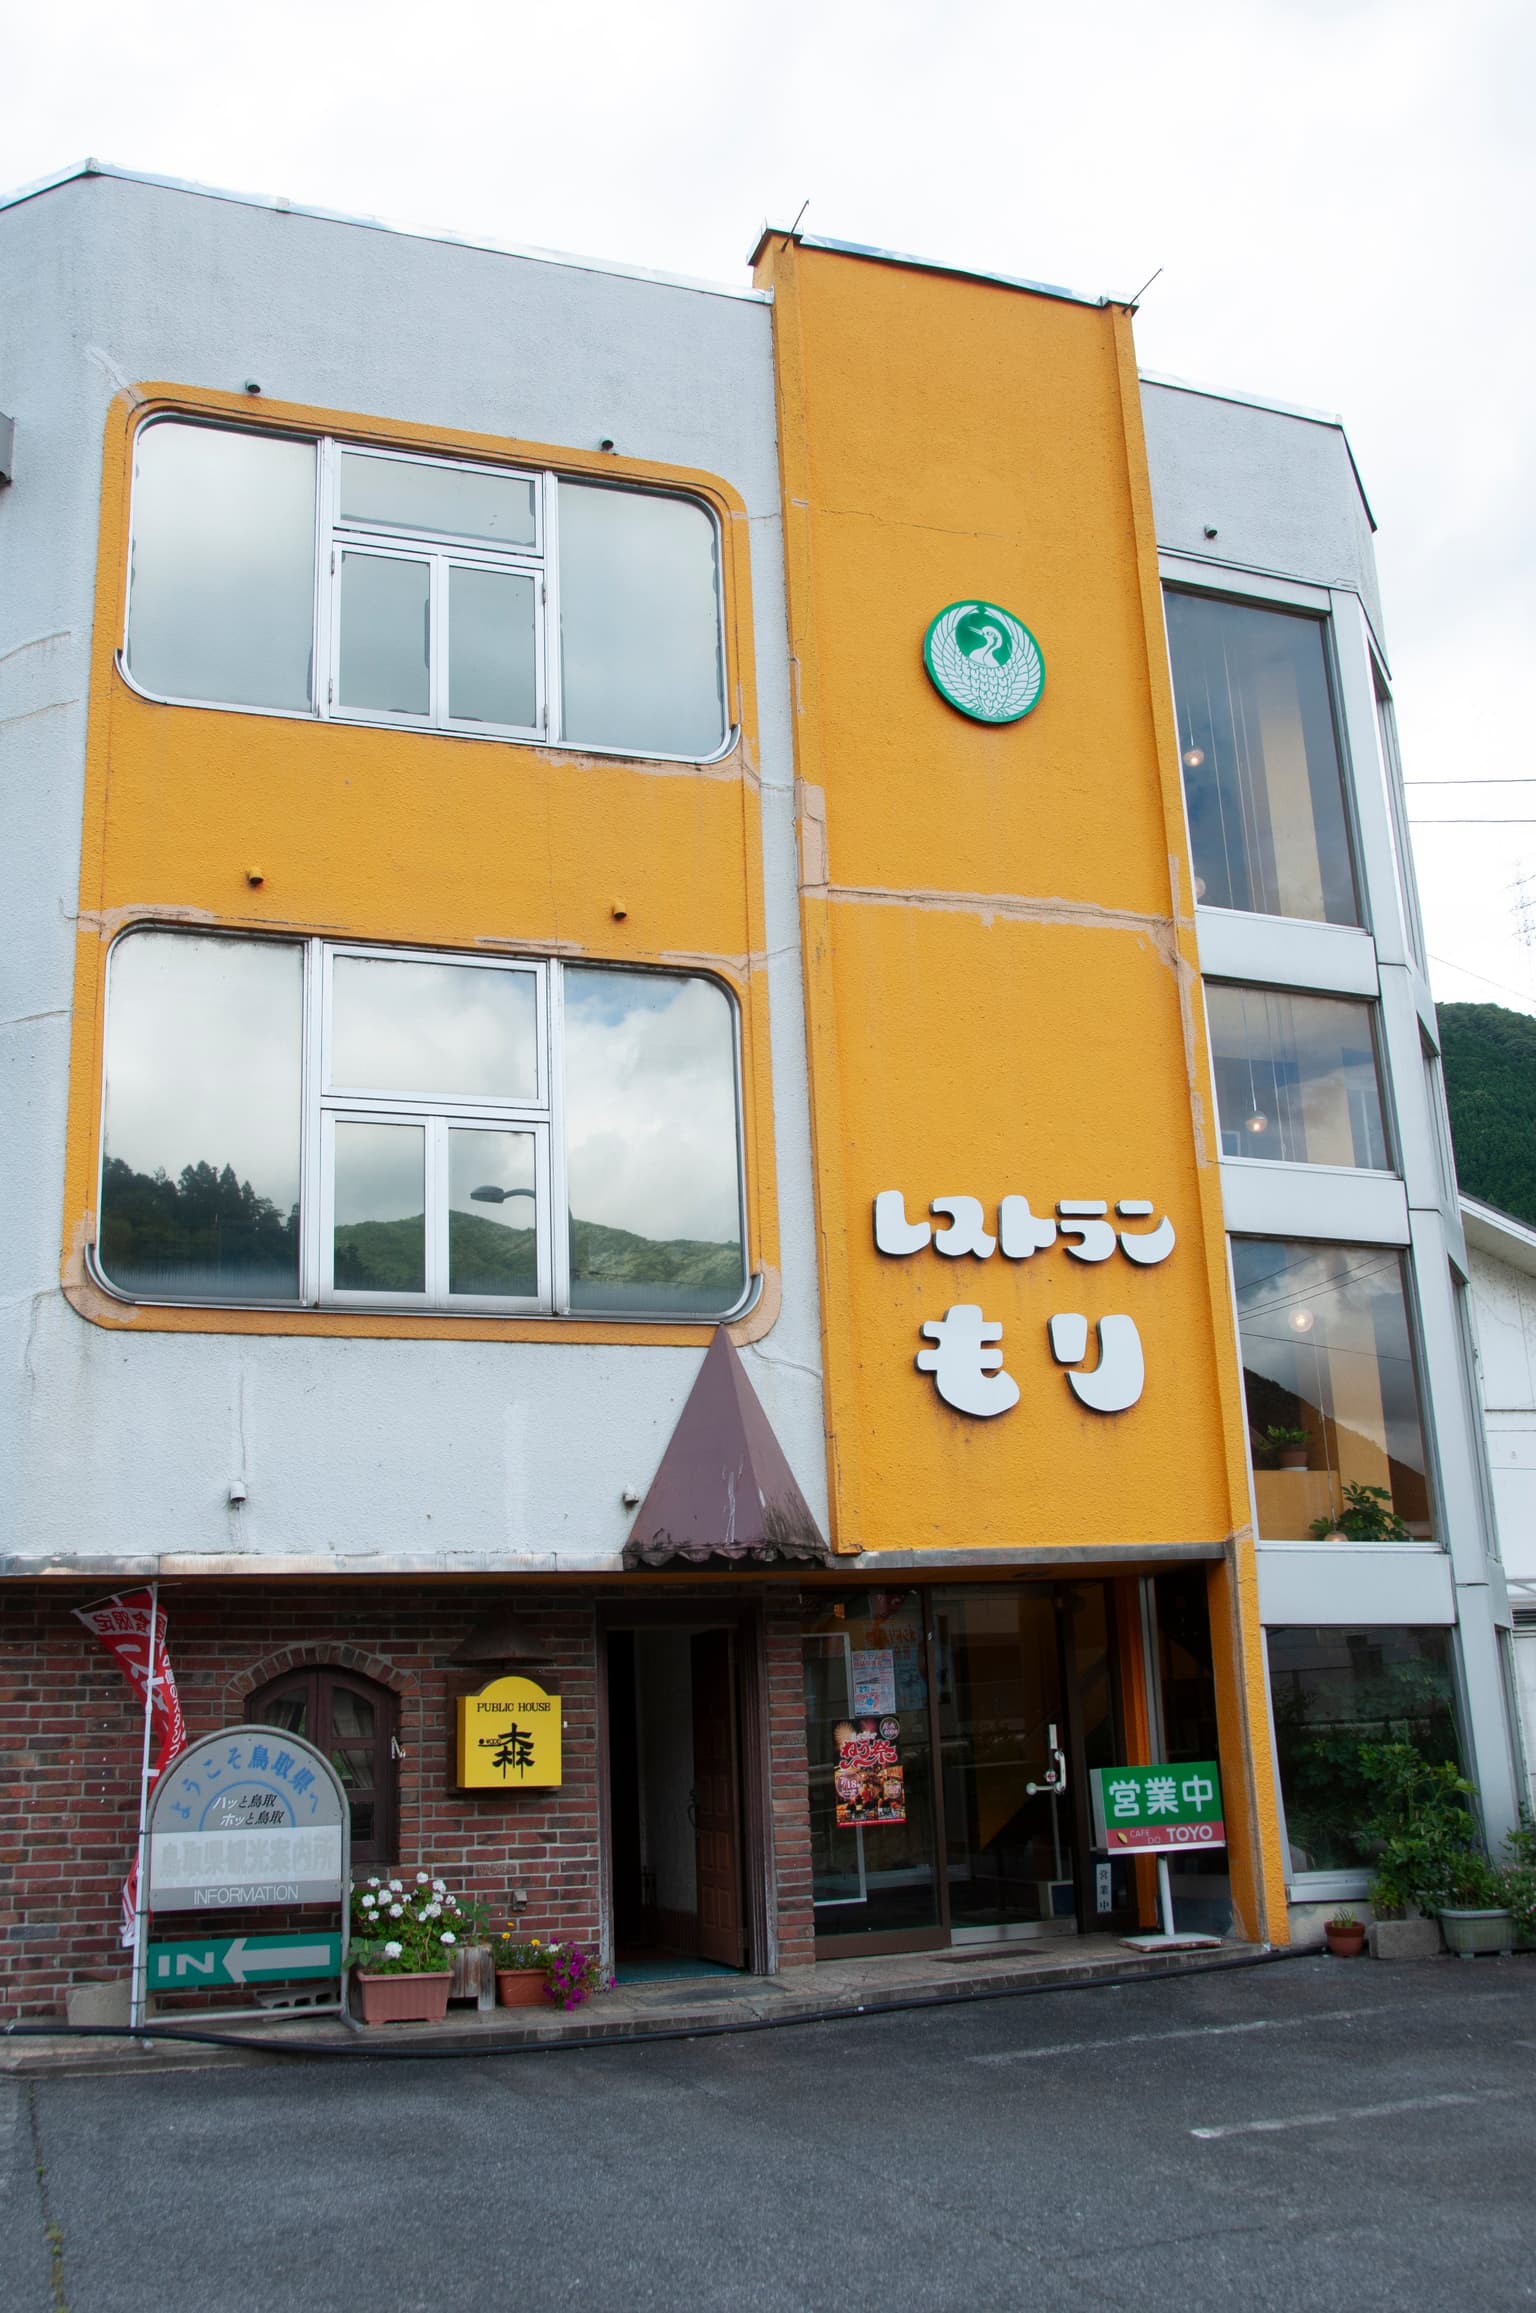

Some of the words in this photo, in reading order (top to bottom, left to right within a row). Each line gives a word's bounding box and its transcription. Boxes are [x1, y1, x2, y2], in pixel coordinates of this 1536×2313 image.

[872, 1189, 1176, 1264] レストラン
[914, 1304, 1145, 1417] もり
[477, 1702, 514, 1713] PUBLIC
[518, 1702, 551, 1712] HOUSE
[488, 1722, 535, 1779] 森
[170, 1744, 319, 1819] ようこそ鳥取県へ
[212, 1794, 278, 1809] ハッと鳥取
[1109, 1775, 1213, 1817] 営業中
[221, 1811, 284, 1826] ホッと鳥取
[1166, 1825, 1213, 1842] TOYO
[193, 1885, 299, 1905] INFORMATION
[158, 1951, 214, 1977] IN
